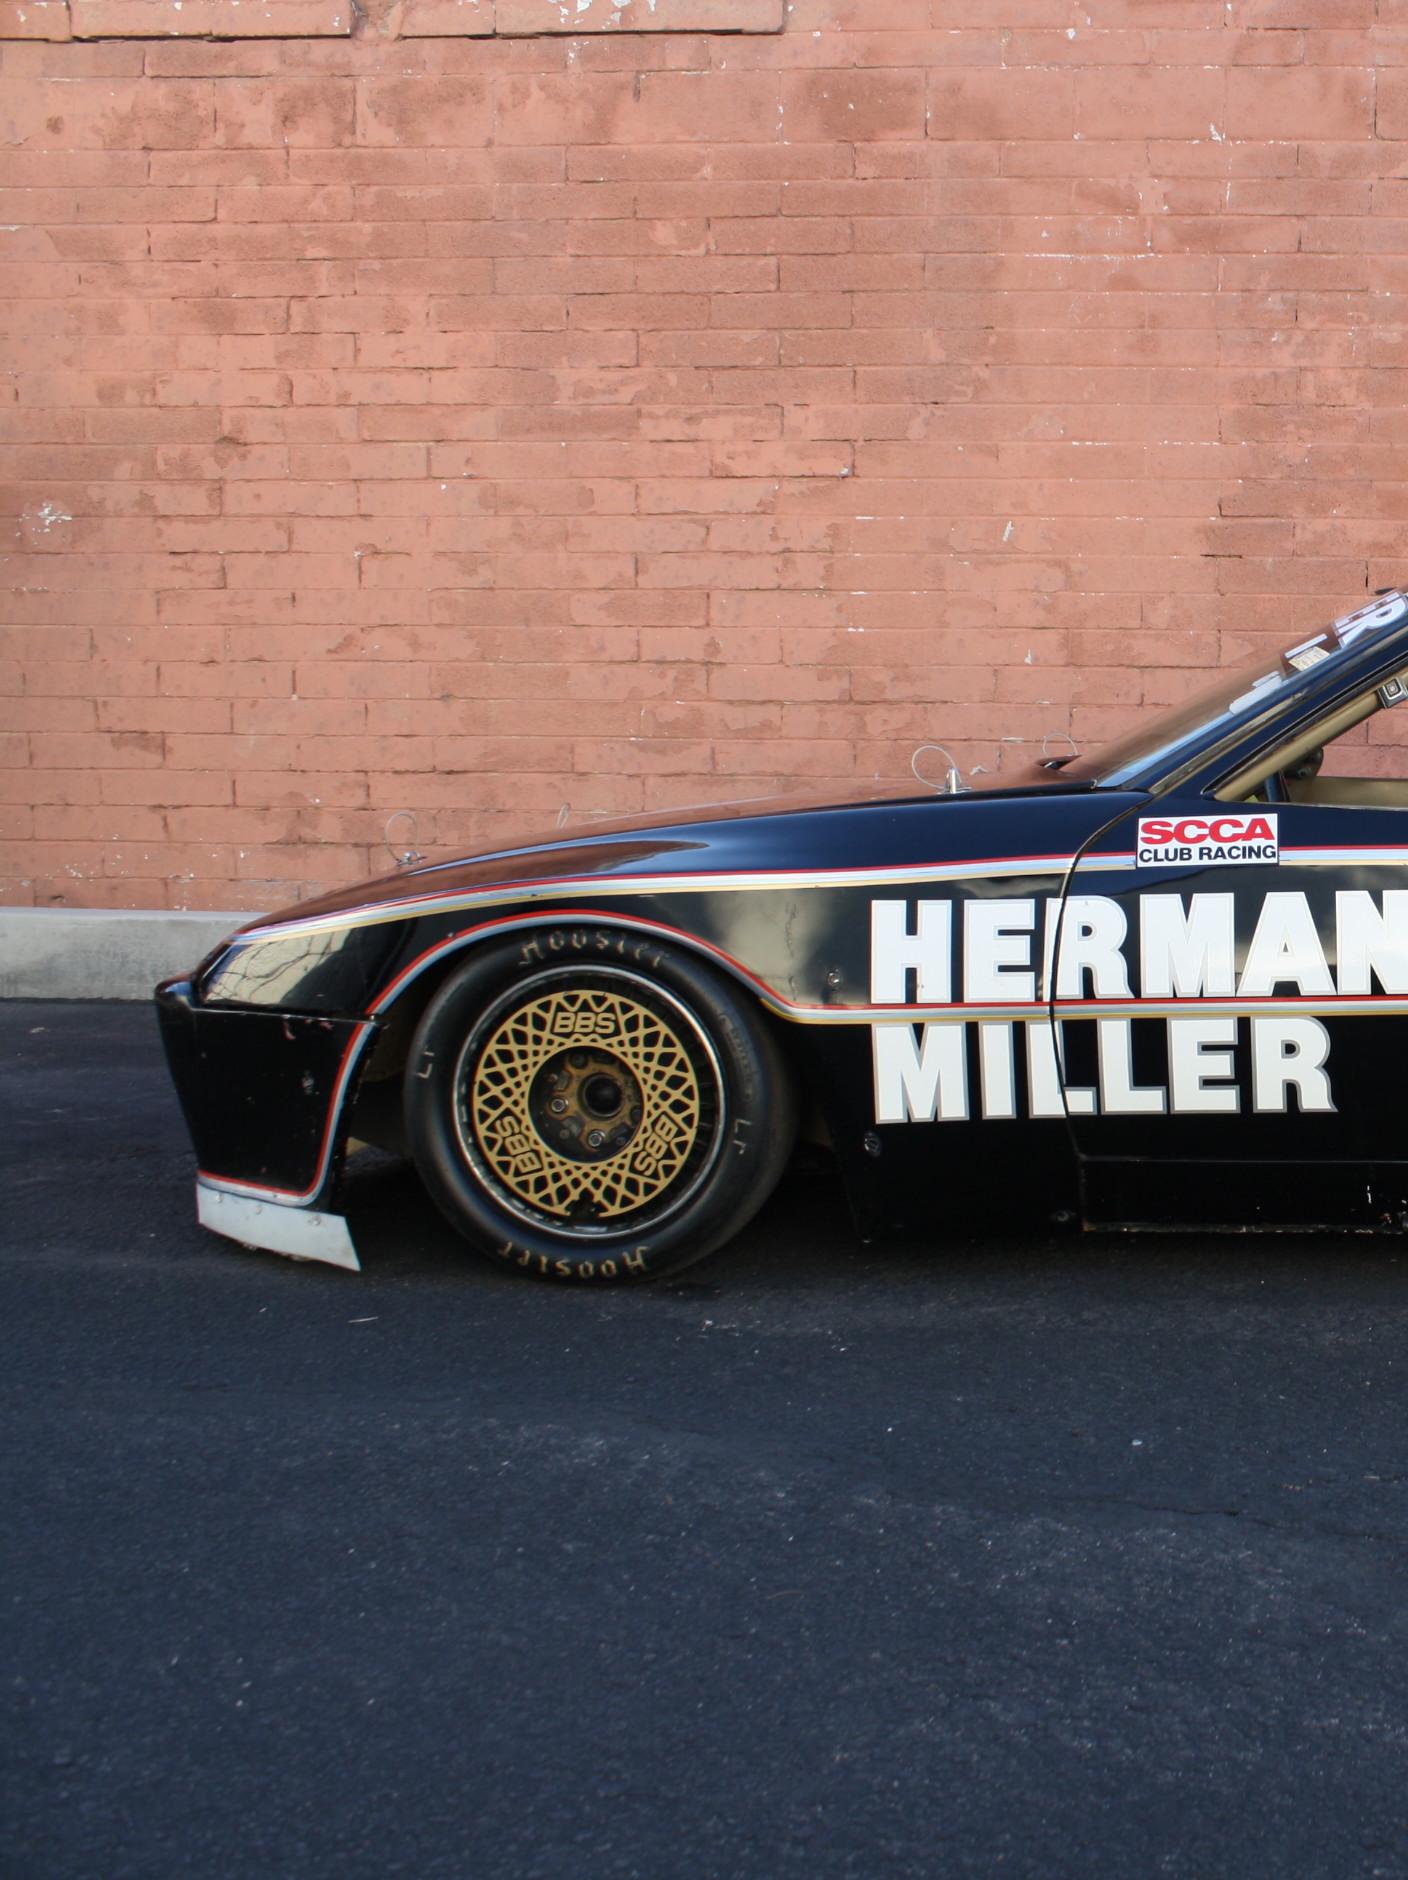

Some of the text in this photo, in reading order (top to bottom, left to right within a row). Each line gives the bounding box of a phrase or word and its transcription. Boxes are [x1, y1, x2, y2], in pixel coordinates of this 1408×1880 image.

[1140, 818, 1276, 845] SCCA
[1139, 845, 1277, 863] CLUB RACING
[552, 1011, 617, 1034] BBS
[871, 1016, 1339, 1125] MILLER
[494, 1115, 542, 1173] BBS
[634, 1115, 678, 1176] BBS
